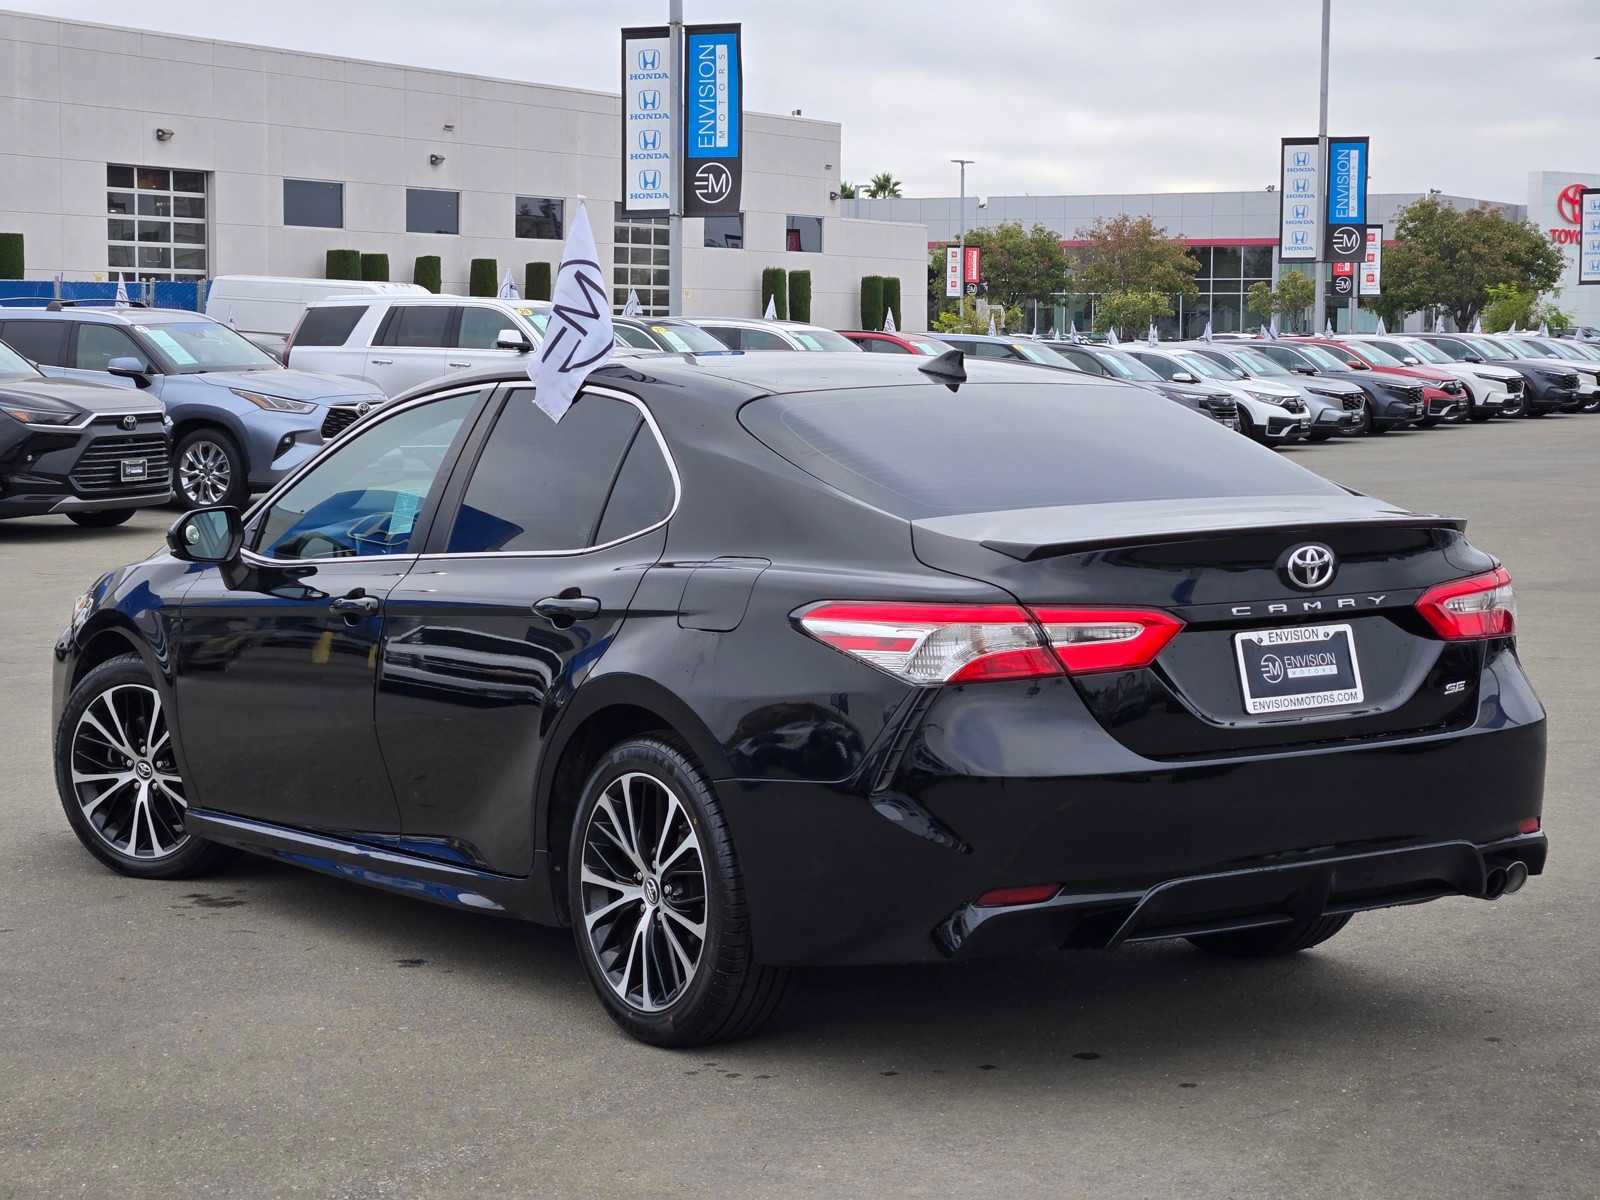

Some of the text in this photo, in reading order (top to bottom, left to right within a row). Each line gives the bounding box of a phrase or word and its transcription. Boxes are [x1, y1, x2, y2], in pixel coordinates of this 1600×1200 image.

[629, 72, 670, 80] HONDA
[698, 44, 715, 148] ENVISION
[629, 112, 670, 120] HONDA
[630, 152, 670, 160] HONDA
[1336, 149, 1350, 218] ENVISION
[630, 192, 670, 200] HONDA
[1231, 594, 1386, 616] CAMRY
[1268, 628, 1320, 644] ENVISION
[1284, 652, 1337, 669] ENVISION
[1444, 680, 1466, 695] SE
[1252, 691, 1359, 711] ENVISIONMOTORS.COM
